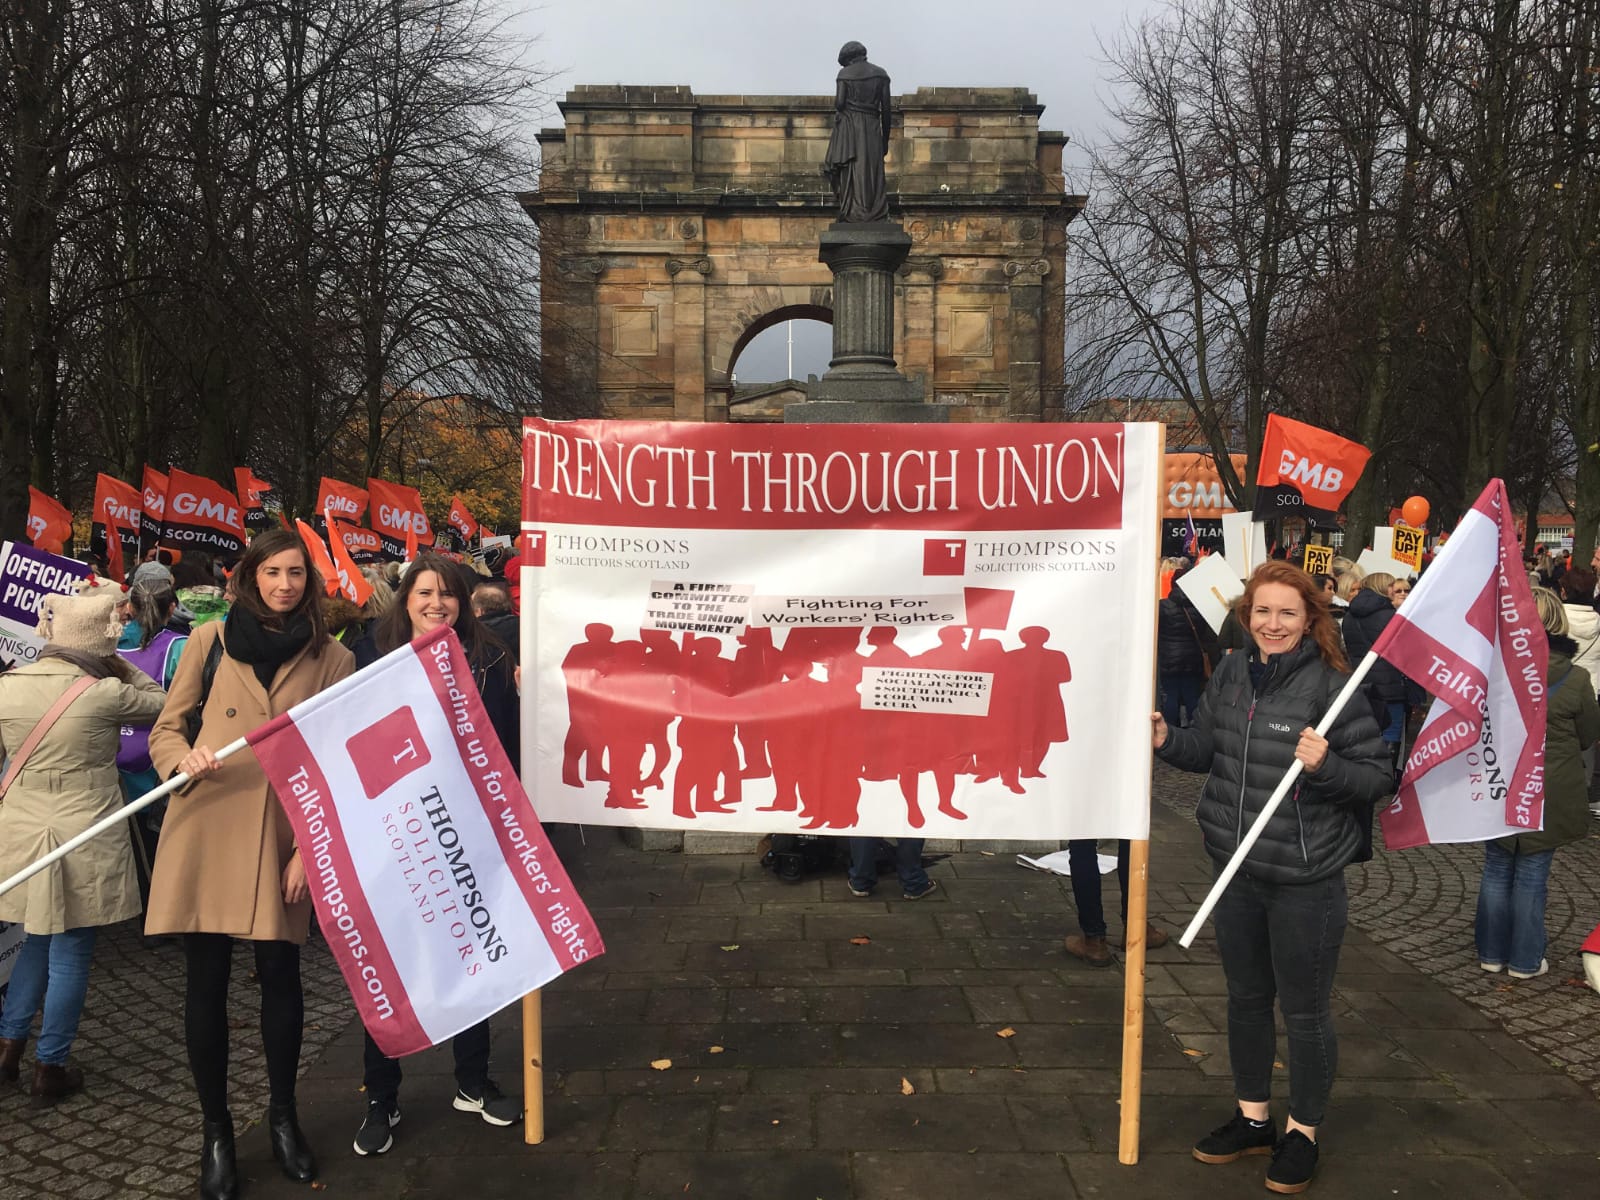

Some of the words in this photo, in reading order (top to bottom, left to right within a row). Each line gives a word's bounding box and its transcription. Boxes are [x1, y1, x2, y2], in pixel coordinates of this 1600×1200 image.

[524, 427, 718, 511] TRENGTH
[731, 448, 960, 514] THROUGH
[976, 431, 1123, 511] UNION
[1278, 449, 1344, 493] GMB
[324, 494, 359, 513] GMB
[379, 504, 428, 535] GMB
[165, 528, 239, 551] SCOTLAND
[342, 532, 377, 546] GMB
[526, 533, 543, 548] T
[554, 534, 690, 555] THOMPSONS
[1396, 530, 1421, 544] PAY
[945, 543, 962, 558] T
[974, 541, 1116, 557] THOMPSONS
[1395, 541, 1419, 556] UP!
[555, 555, 623, 568] SOLICITORS
[624, 558, 690, 570] SCOTLAND
[1308, 551, 1331, 564] PAY
[974, 562, 1045, 573] SOLICITORS
[1047, 561, 1116, 573] SCOTLAND
[1306, 563, 1328, 575] UP!
[673, 583, 685, 591] A
[689, 583, 732, 592] FIRM
[3, 582, 46, 614] PICK
[651, 591, 748, 604] COMMITTED
[786, 598, 883, 611] Fighting
[890, 598, 928, 608] For
[672, 602, 692, 610] TO
[695, 603, 724, 612] THE
[1500, 594, 1519, 623] up
[648, 610, 695, 621] TRADE
[697, 614, 744, 625] UNION
[762, 613, 868, 623] Workers'
[875, 612, 955, 625] Rights
[656, 621, 734, 634] MOVEMENT
[0, 636, 41, 660] NISO
[1509, 627, 1533, 658] for
[876, 678, 926, 687] SOCIAL
[881, 670, 951, 680] FIGHTING
[955, 674, 983, 682] FOR
[884, 686, 929, 695] SOUTH
[935, 689, 980, 697] AFRICA
[883, 701, 917, 709] CUBA
[1274, 723, 1290, 732] Rab
[392, 738, 418, 767] T
[1482, 706, 1508, 801] PSONS
[430, 639, 474, 737] Standing
[468, 738, 490, 769] up
[482, 769, 507, 803] for
[499, 805, 560, 896] workers'
[547, 901, 590, 965] rights
[382, 812, 436, 925] SCOTLAND
[420, 785, 508, 964] THOMPSONS
[287, 765, 394, 1021] TalkToThompsons.com
[397, 801, 482, 977] SOLICITORS
